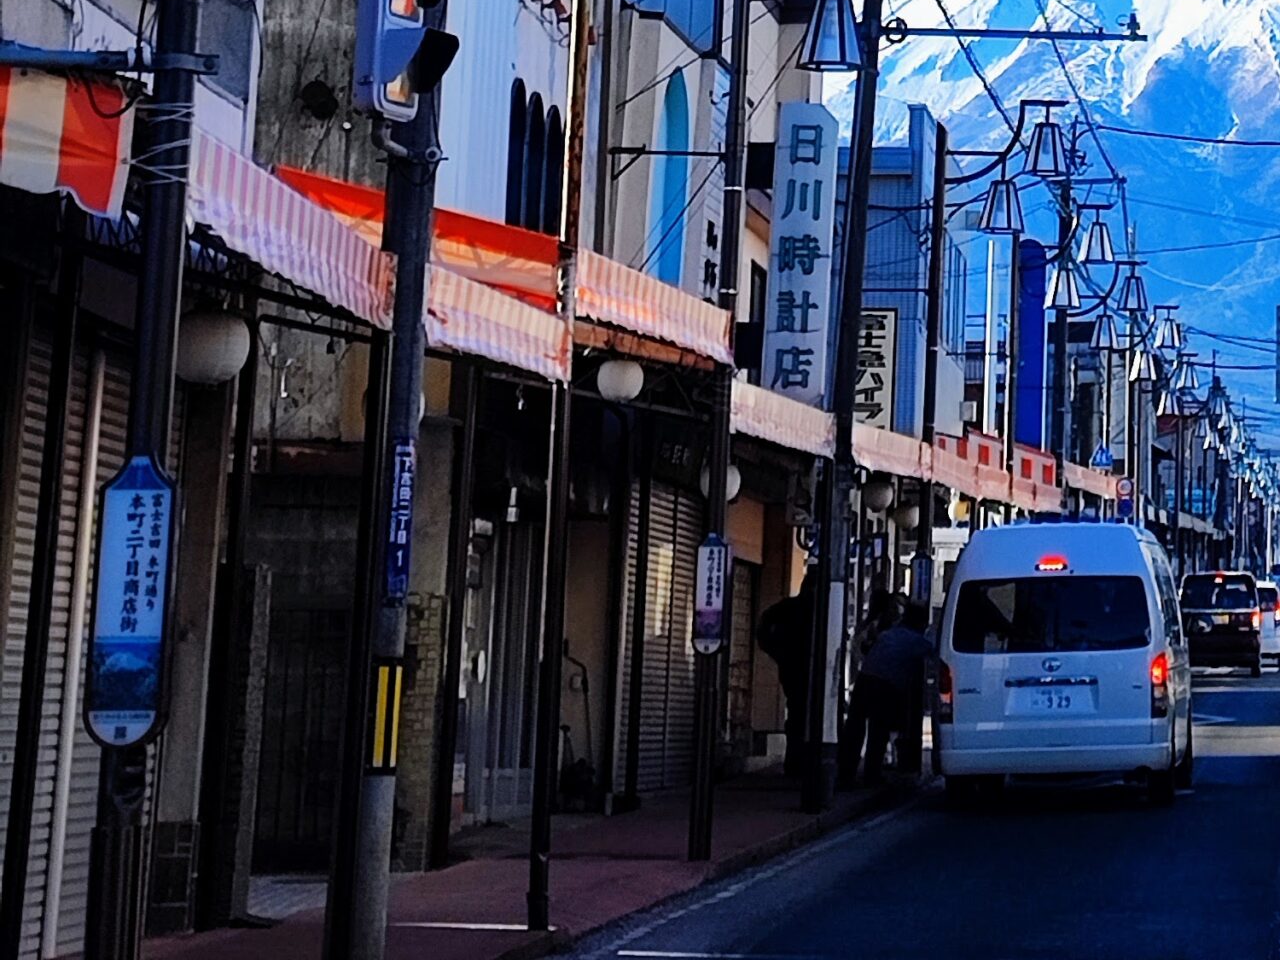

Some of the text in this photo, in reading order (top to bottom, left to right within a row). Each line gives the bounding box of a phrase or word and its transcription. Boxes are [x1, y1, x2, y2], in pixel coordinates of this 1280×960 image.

[770, 123, 824, 390] 日川時計店
[119, 492, 146, 633] 本町二丁目商店街
[144, 492, 165, 611] 富士吉田 本町通り
[396, 549, 404, 567] 1
